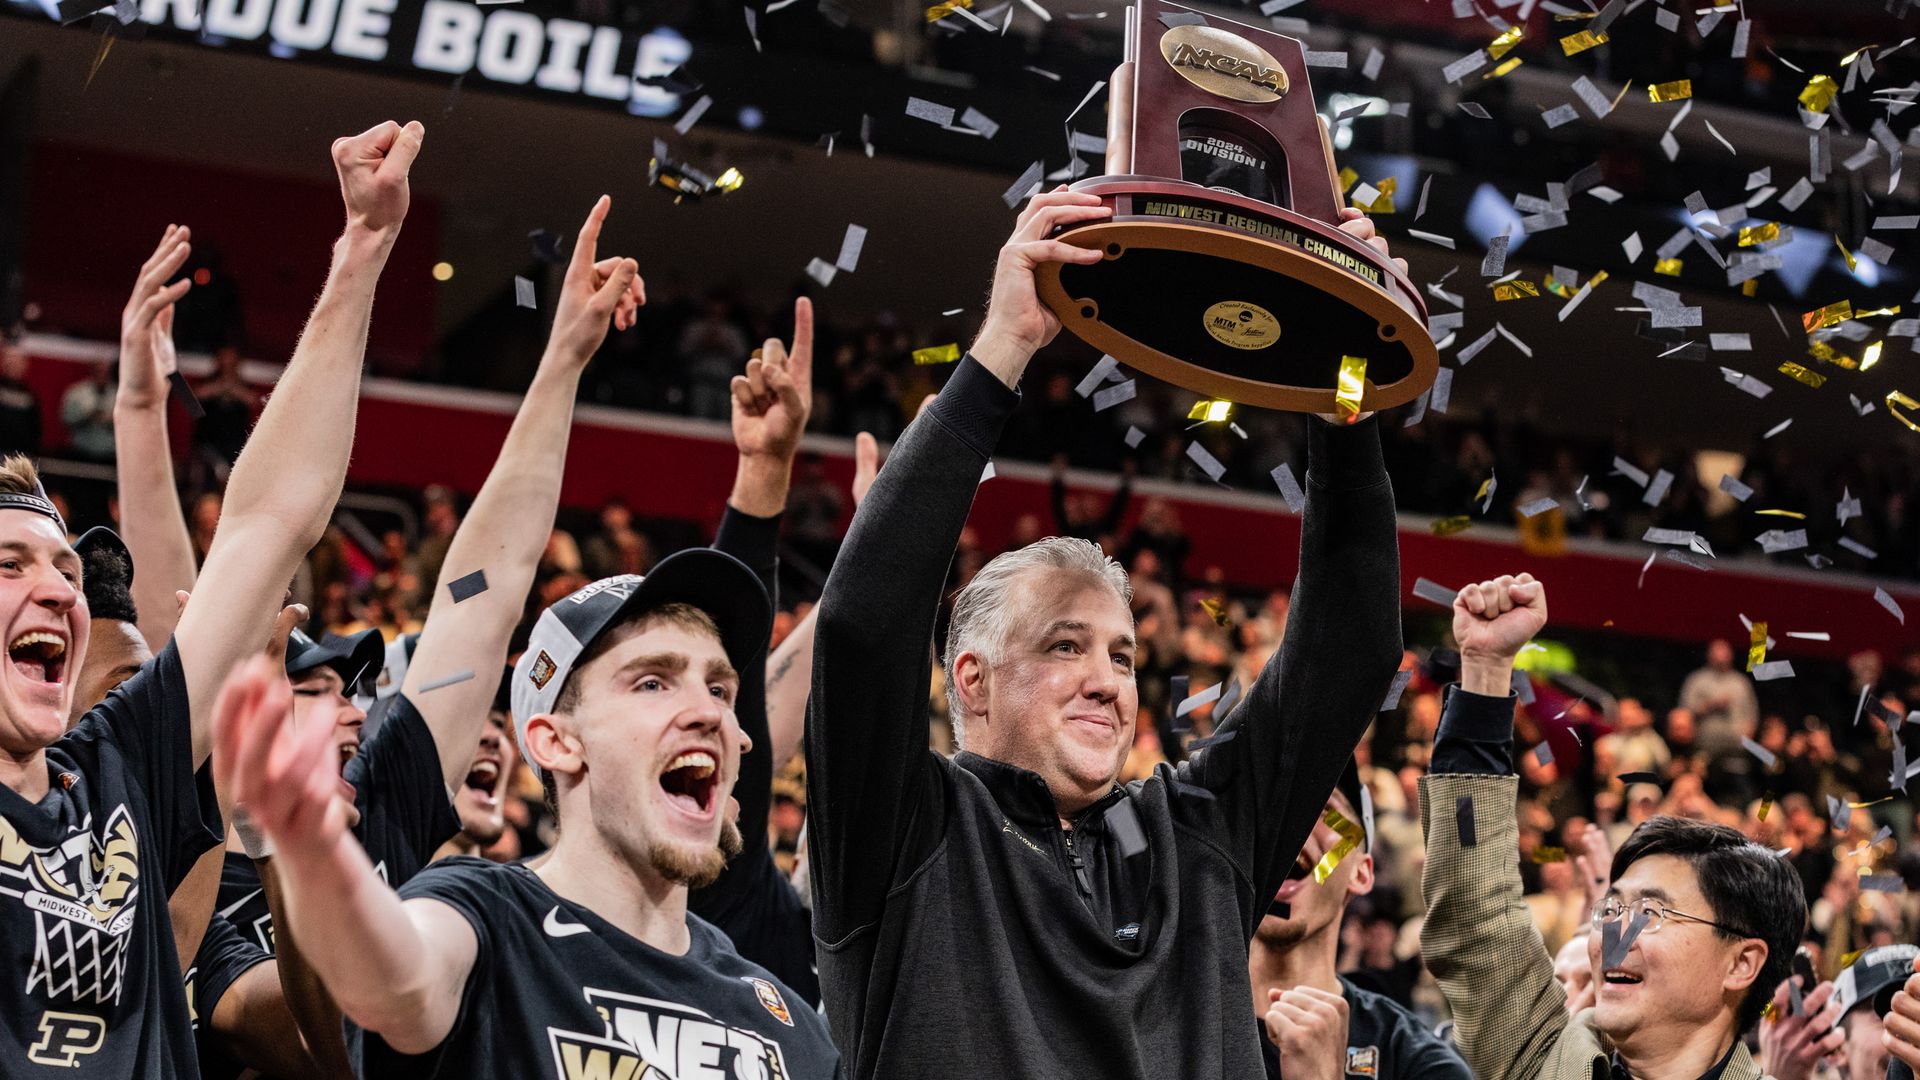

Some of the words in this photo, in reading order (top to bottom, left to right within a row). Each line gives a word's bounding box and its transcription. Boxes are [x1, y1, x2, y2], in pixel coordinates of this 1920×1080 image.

[1171, 43, 1286, 91] NCAA
[1186, 139, 1257, 167] DIVISION
[1260, 160, 1267, 170] I
[1206, 137, 1244, 153] 2024
[1145, 201, 1223, 224] MIDWEST
[1225, 213, 1301, 247] REGIONAL
[1303, 237, 1379, 284] CHAMPION
[1213, 316, 1237, 330] MTM
[37, 897, 89, 921] MIDWEST
